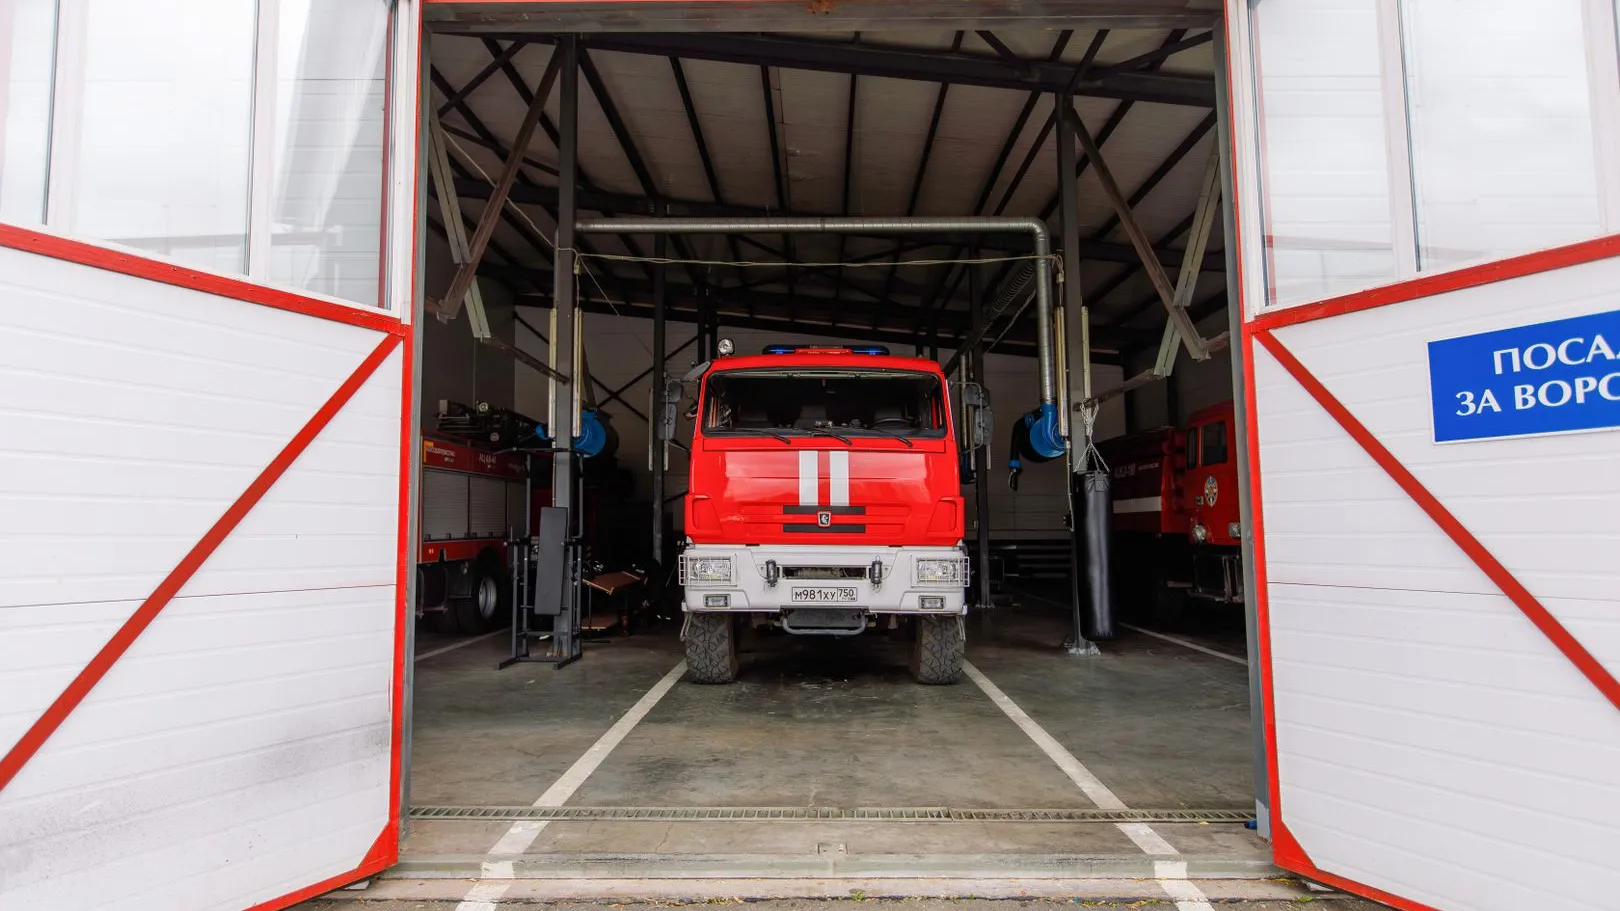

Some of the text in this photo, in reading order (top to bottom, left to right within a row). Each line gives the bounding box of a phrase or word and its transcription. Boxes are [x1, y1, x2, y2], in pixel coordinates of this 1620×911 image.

[1493, 334, 1620, 375] ПОСА
[1455, 389, 1502, 416] ЗА
[838, 588, 855, 597] 750
